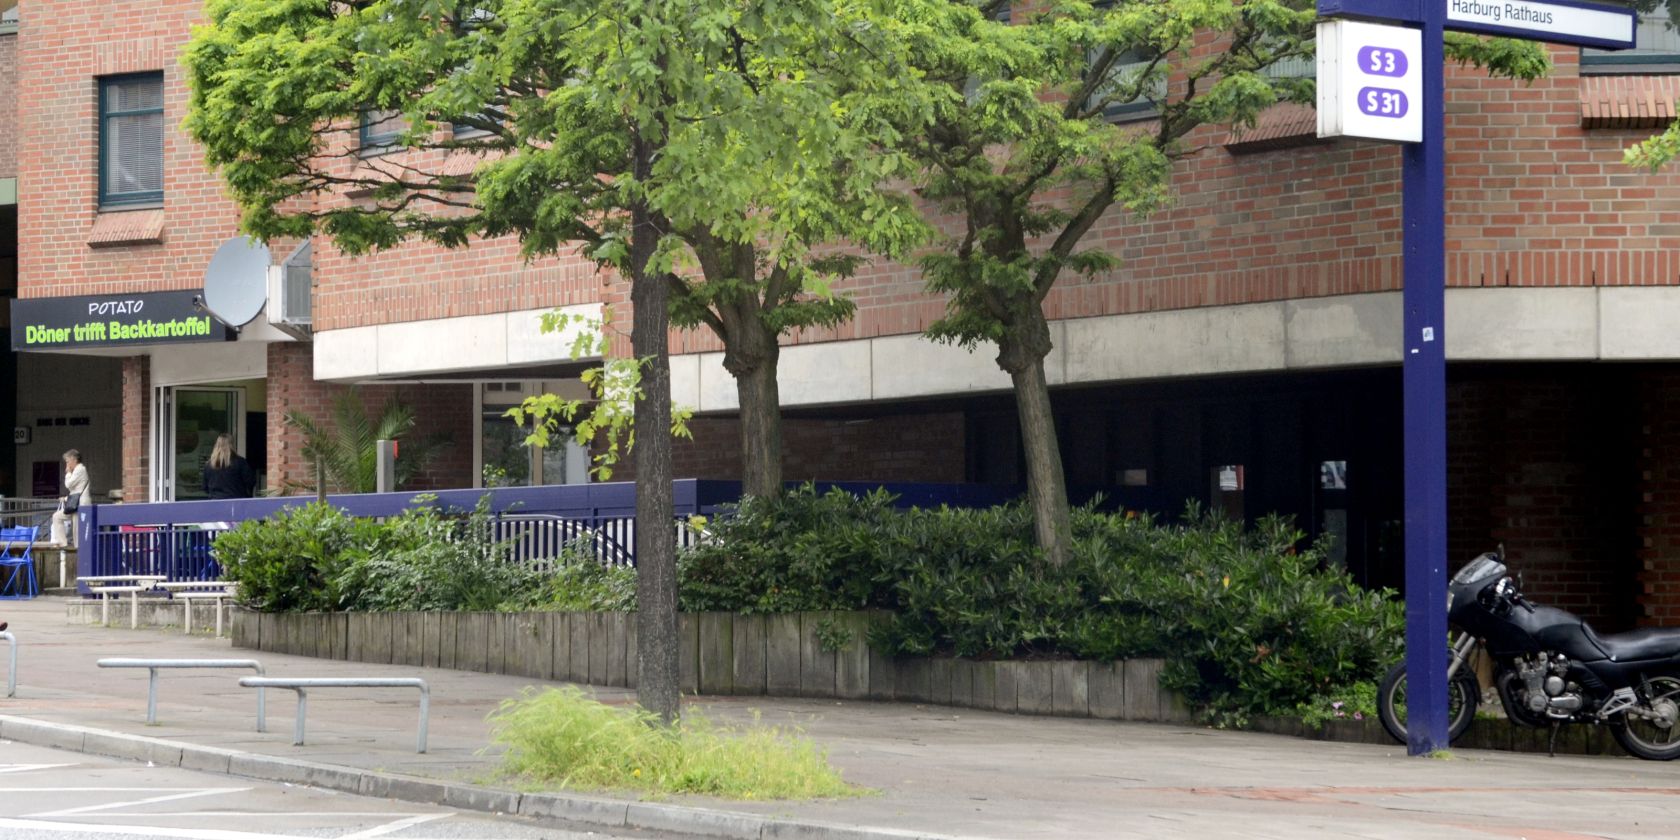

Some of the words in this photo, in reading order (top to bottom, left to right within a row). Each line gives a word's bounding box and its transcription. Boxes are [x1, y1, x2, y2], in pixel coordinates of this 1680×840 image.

[1452, 0, 1501, 21] Harburg
[1505, 3, 1553, 25] Rathaus
[1370, 49, 1382, 72] S
[1384, 52, 1396, 73] 3
[1366, 90, 1379, 112] S
[1381, 92, 1400, 115] 31
[88, 300, 144, 316] POTATO
[25, 324, 71, 344] Döner
[73, 322, 107, 342] trifft
[109, 316, 211, 340] Backkartoffel
